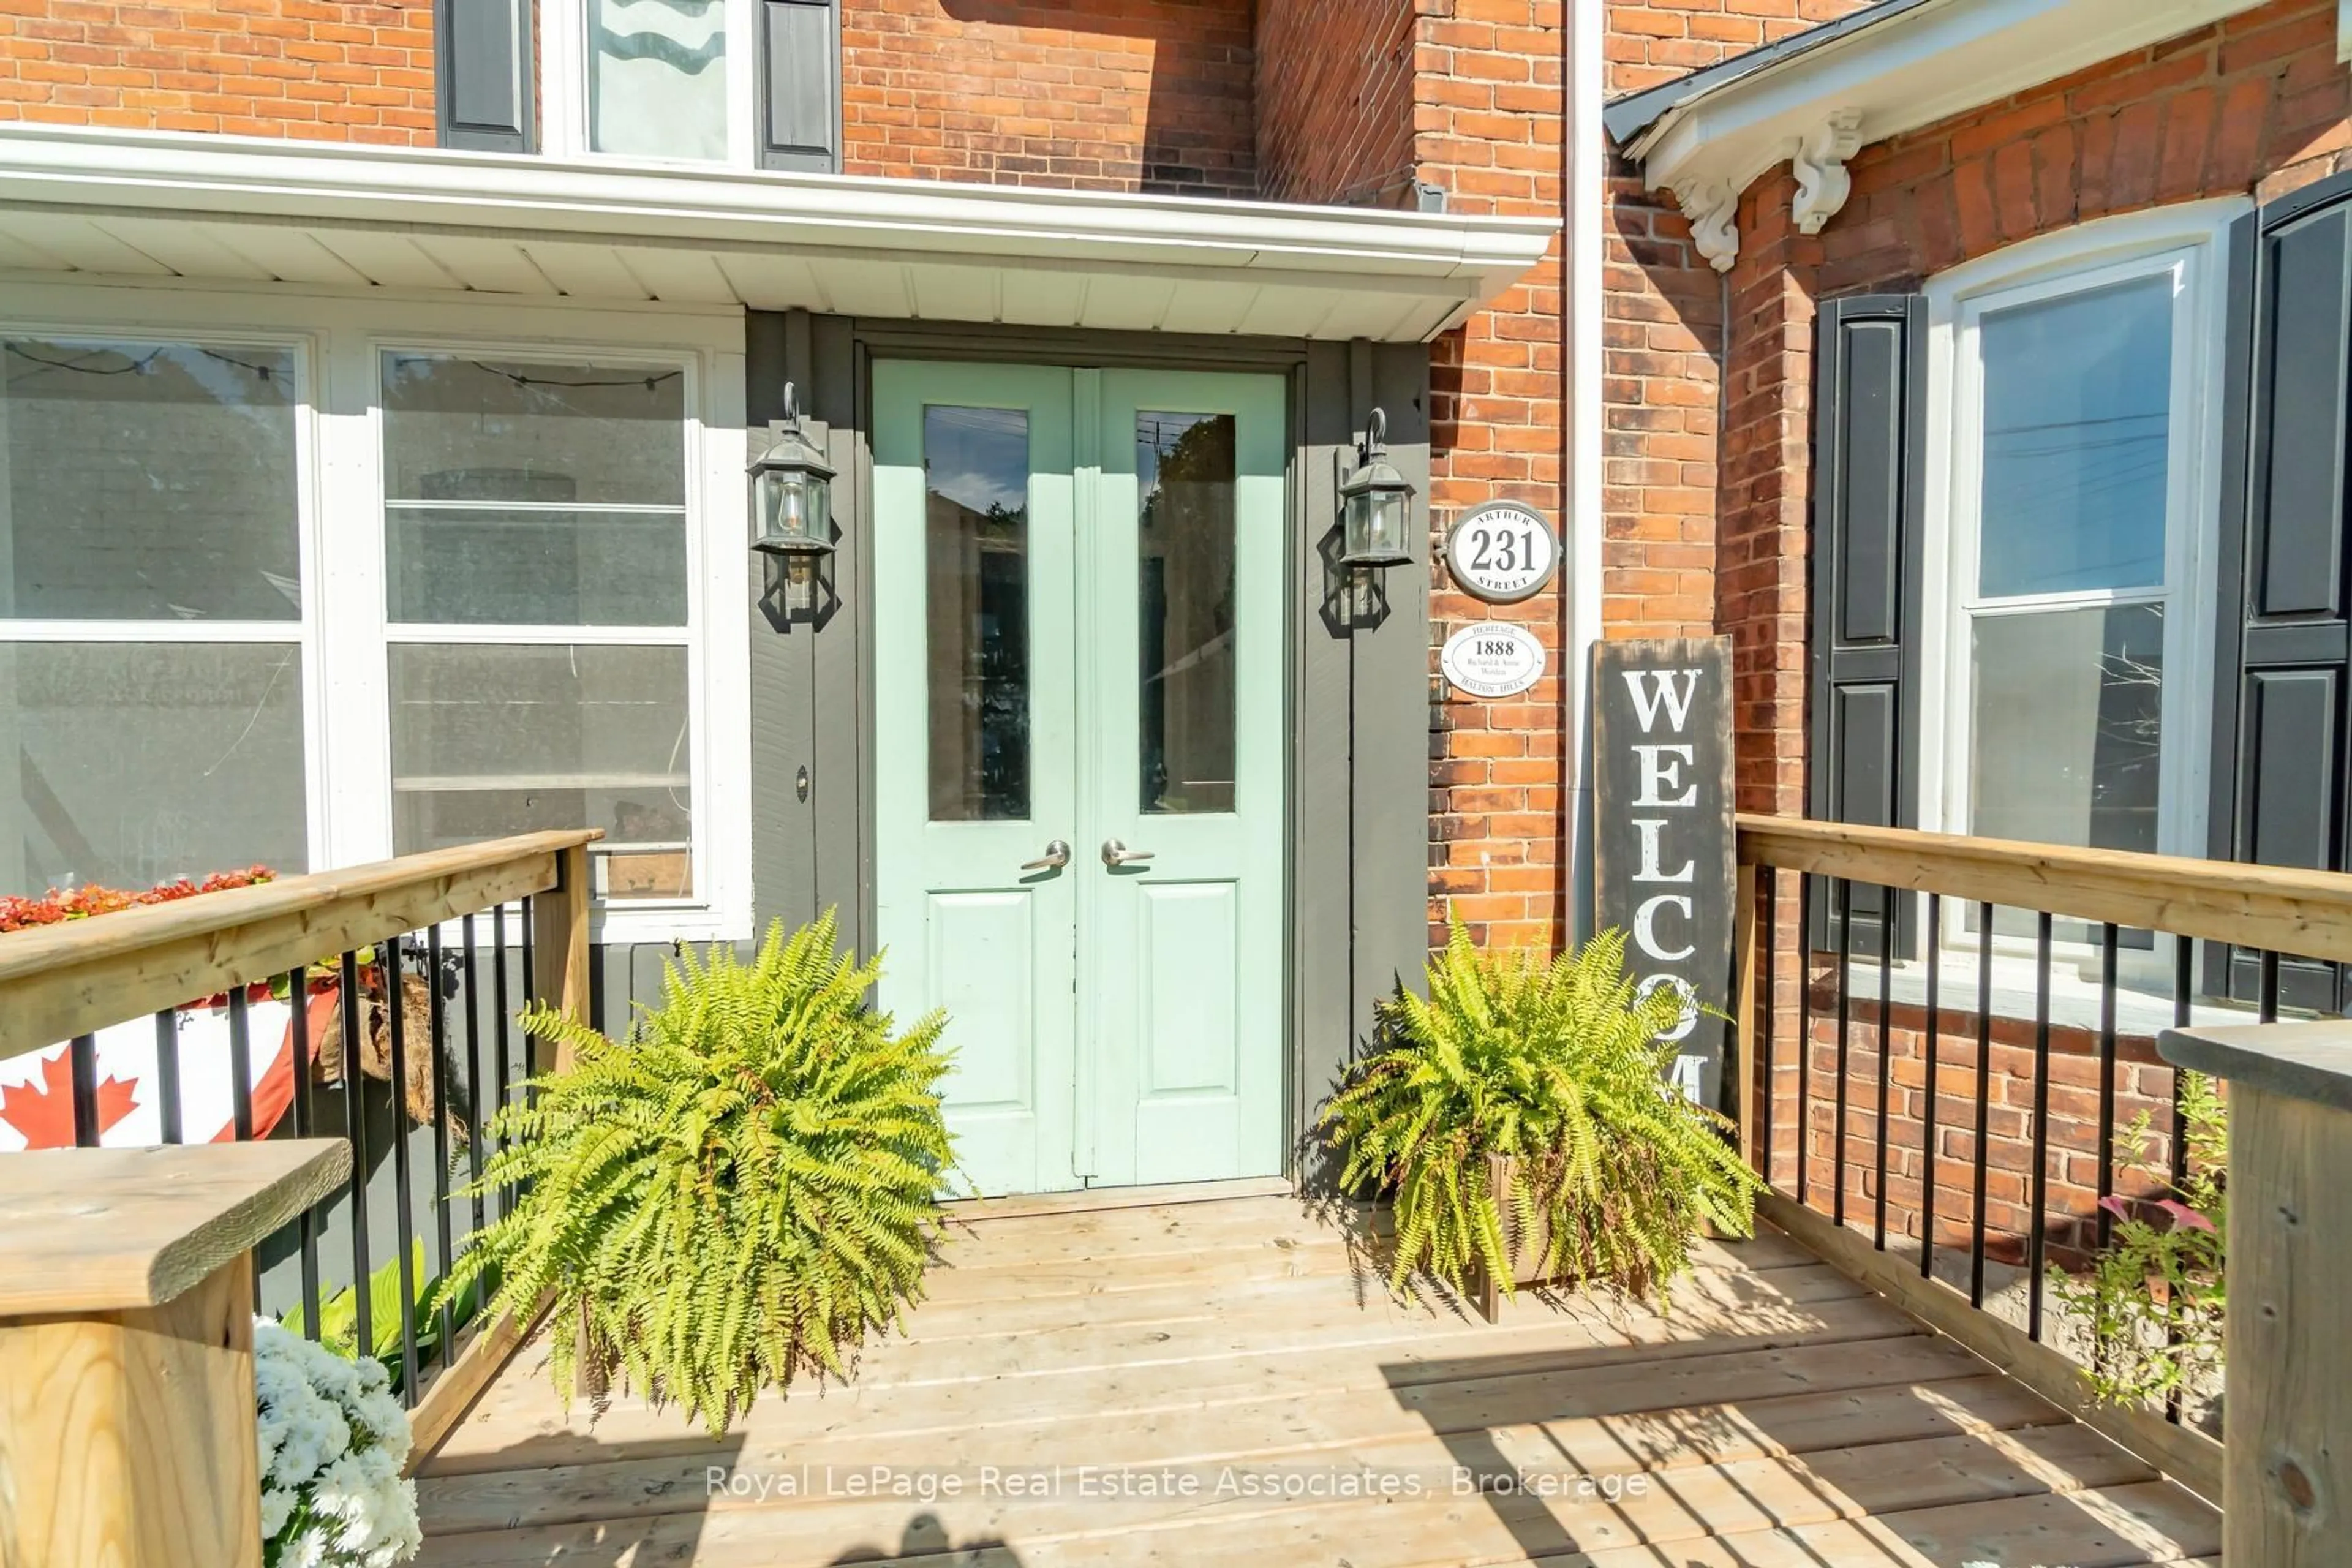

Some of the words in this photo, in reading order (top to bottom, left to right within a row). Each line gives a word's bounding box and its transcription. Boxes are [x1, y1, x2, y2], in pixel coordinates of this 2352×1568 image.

[1477, 511, 1531, 527] ARTHUR
[1471, 529, 1535, 571] 231
[1477, 575, 1528, 590] STREET
[1472, 625, 1516, 635] HERITAGE
[1476, 640, 1515, 656] 1888
[1461, 677, 1494, 693] HALTON
[1499, 680, 1525, 693] HILLS
